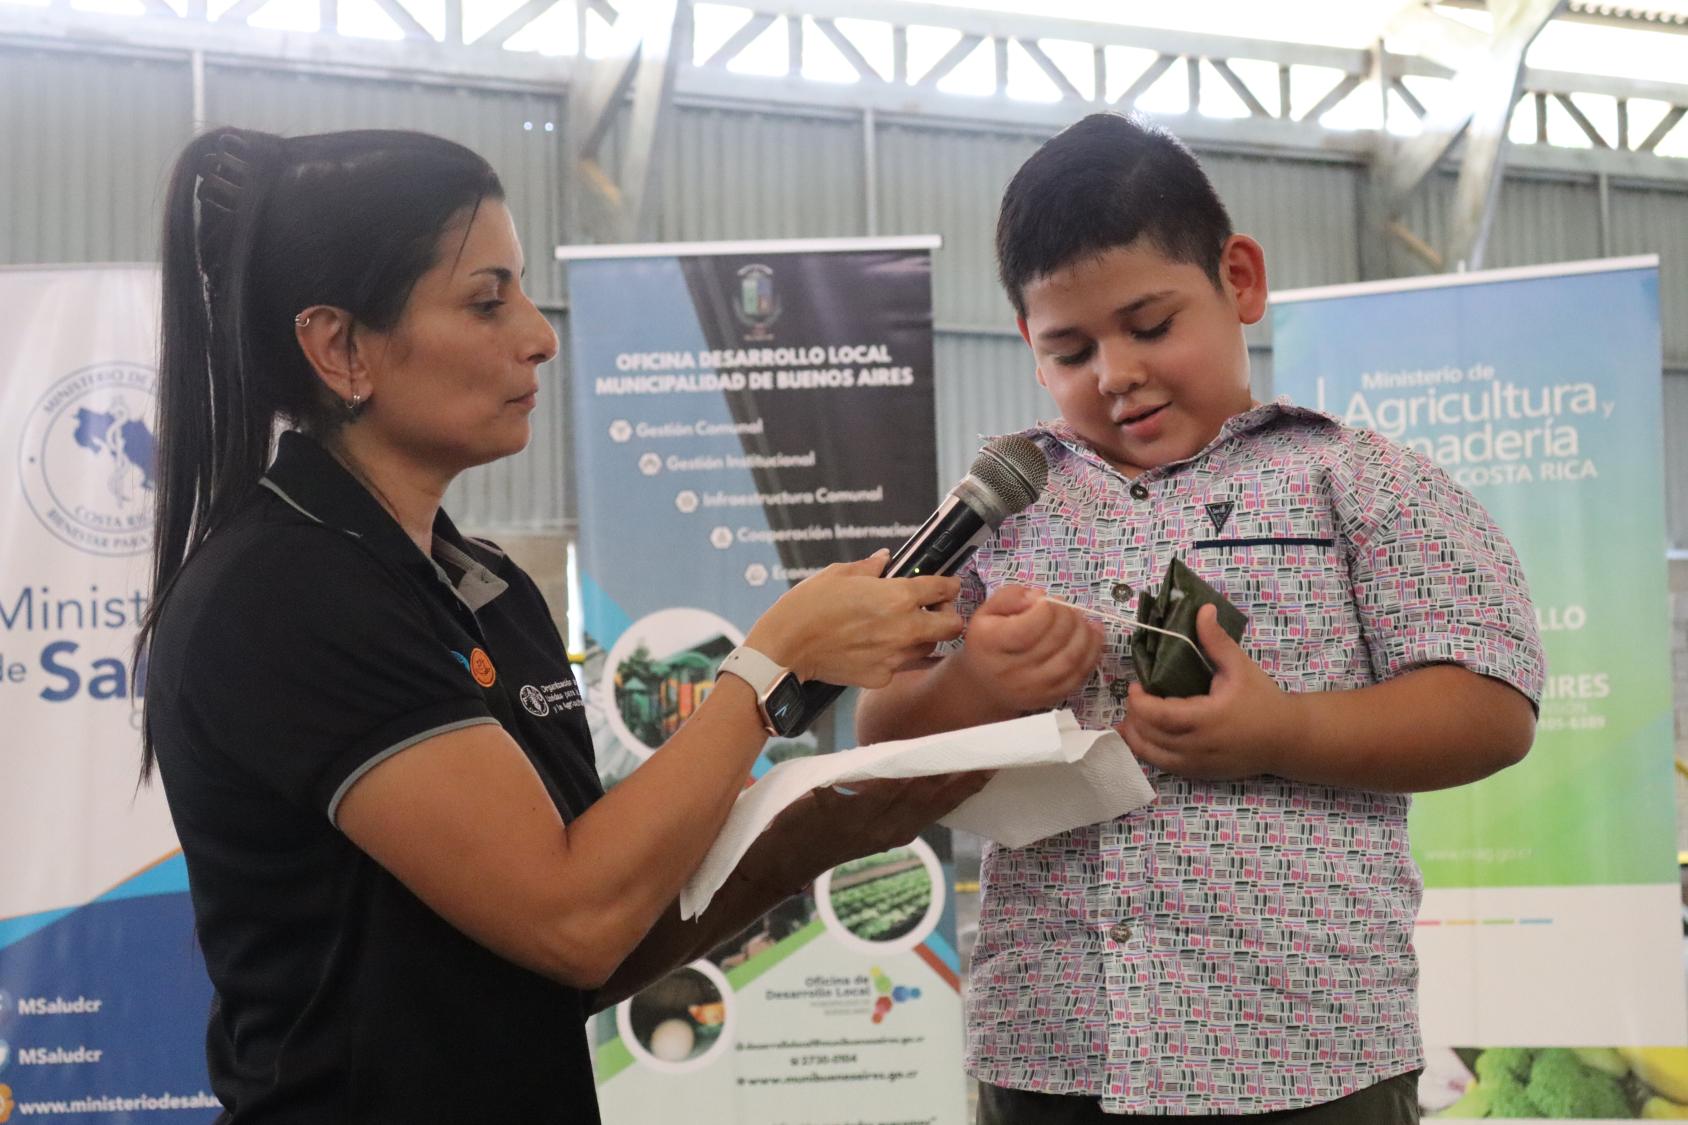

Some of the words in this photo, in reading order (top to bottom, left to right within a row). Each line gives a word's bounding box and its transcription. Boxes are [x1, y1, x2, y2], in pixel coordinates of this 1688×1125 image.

[616, 351, 697, 371] OFICINA
[700, 347, 826, 367] DESARROLLO
[829, 345, 892, 364] LOCAL
[595, 373, 747, 394] MUNICIPALIDAD
[750, 371, 774, 390] DE
[777, 369, 854, 388] BUENOS
[857, 366, 914, 386] AIRES
[1361, 367, 1463, 390] Ministerio
[1468, 364, 1495, 382] de
[1344, 381, 1597, 437] Agricultura
[1603, 401, 1615, 418] y
[635, 420, 693, 438] Gestión
[695, 418, 763, 436] Comunal
[1406, 418, 1579, 466] nadería
[666, 453, 723, 471] Gestión
[1454, 464, 1534, 486] COSTA
[1540, 459, 1598, 481] RICA
[815, 485, 883, 503] Comunal
[0, 584, 149, 631] Minist
[1543, 673, 1612, 699] IRES
[805, 976, 850, 988] Oficina
[854, 975, 869, 986] de
[835, 986, 870, 998] Local
[18, 995, 102, 1016] MSaludcr
[18, 1046, 102, 1066] MSaludcr
[19, 1089, 225, 1116] www.ministeriodesalu
